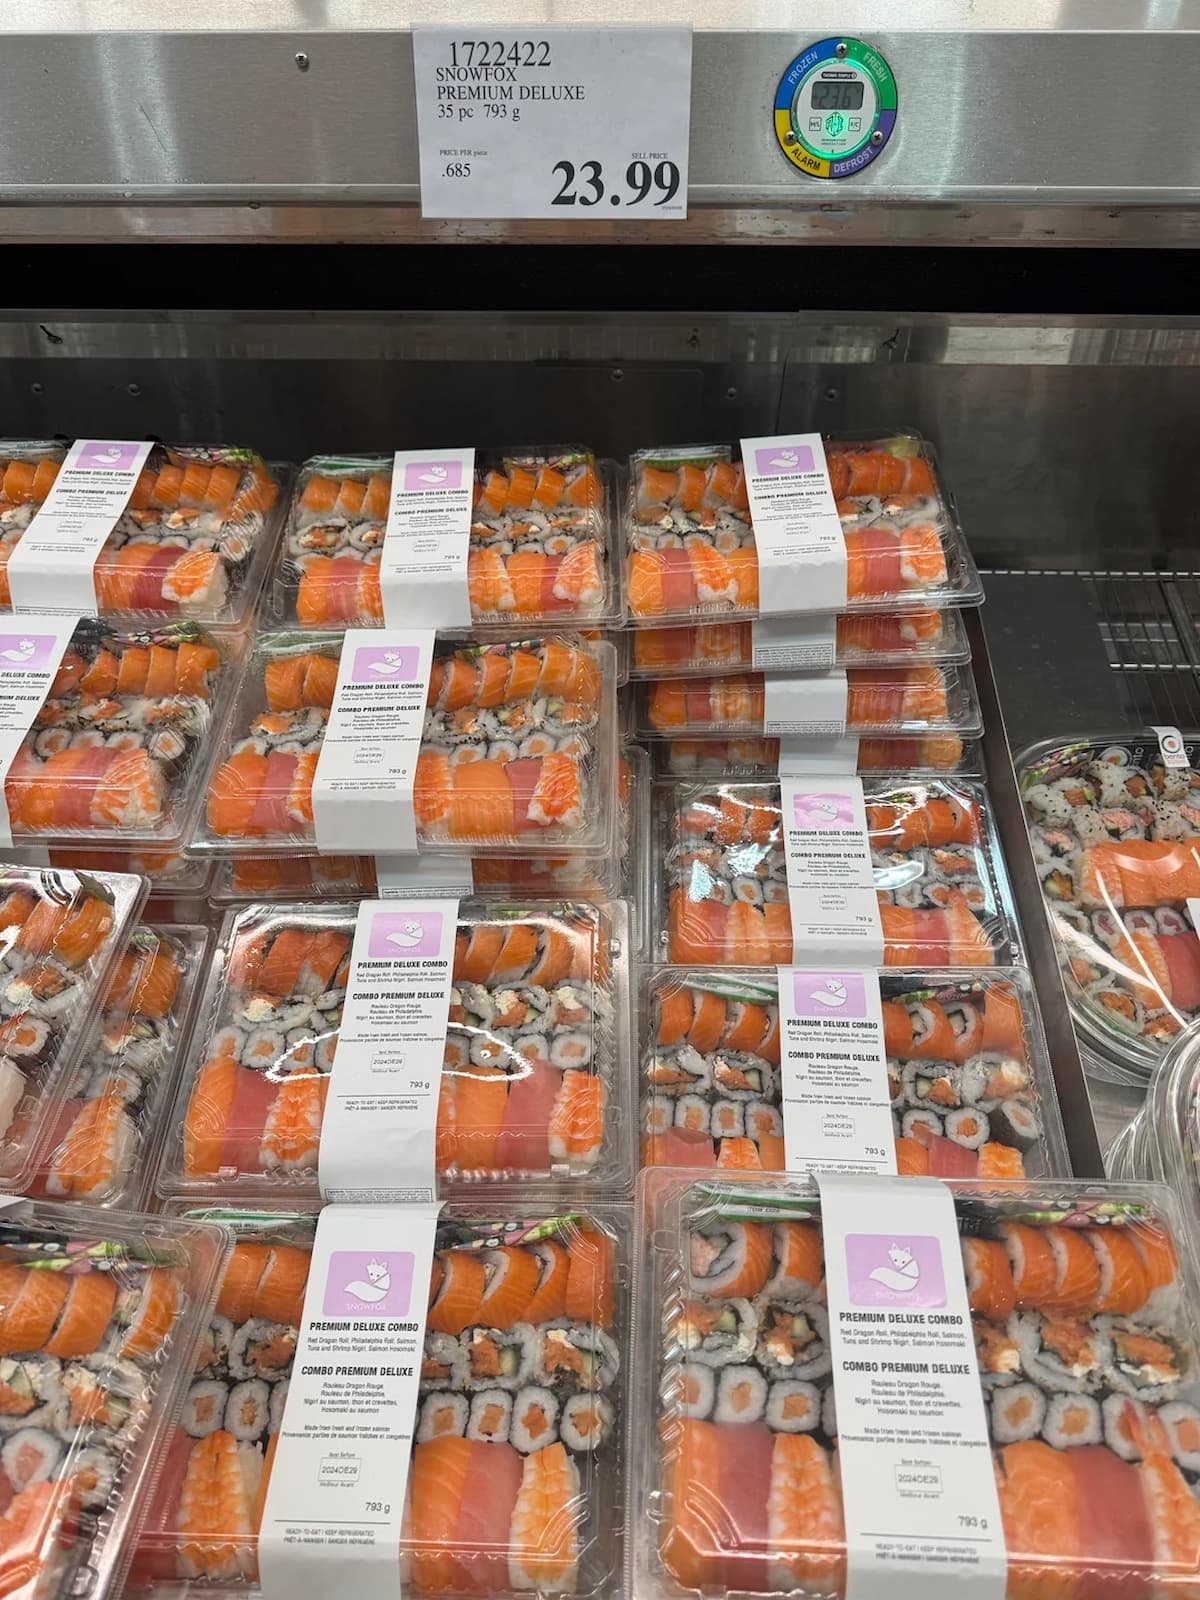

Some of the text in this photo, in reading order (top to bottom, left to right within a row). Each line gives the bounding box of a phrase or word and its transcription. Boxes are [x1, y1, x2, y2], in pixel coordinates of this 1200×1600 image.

[450, 41, 552, 66] 1722422
[788, 51, 818, 84] FROZEN
[864, 52, 888, 82] FRESH
[436, 68, 518, 82] SNOWFOX
[437, 86, 585, 100] PREMIUM DELUXE
[438, 104, 520, 122] 35 pc 793 g
[791, 148, 820, 170] ALARM
[834, 146, 874, 173] DEFROST
[442, 162, 471, 178] .685
[551, 160, 680, 206] 23.99
[839, 1312, 963, 1325] PREMIUM DELUXE COMBO
[310, 1322, 419, 1332] PREMIUM DELUXE COMBO
[301, 1366, 413, 1376] COMBO PREMIUM DELUXE
[843, 1361, 970, 1374] COMBO PREMIUM DELUXE
[322, 1466, 358, 1474] 2024DE29
[366, 1502, 391, 1514] 793 g
[958, 1516, 988, 1529] 793 g
